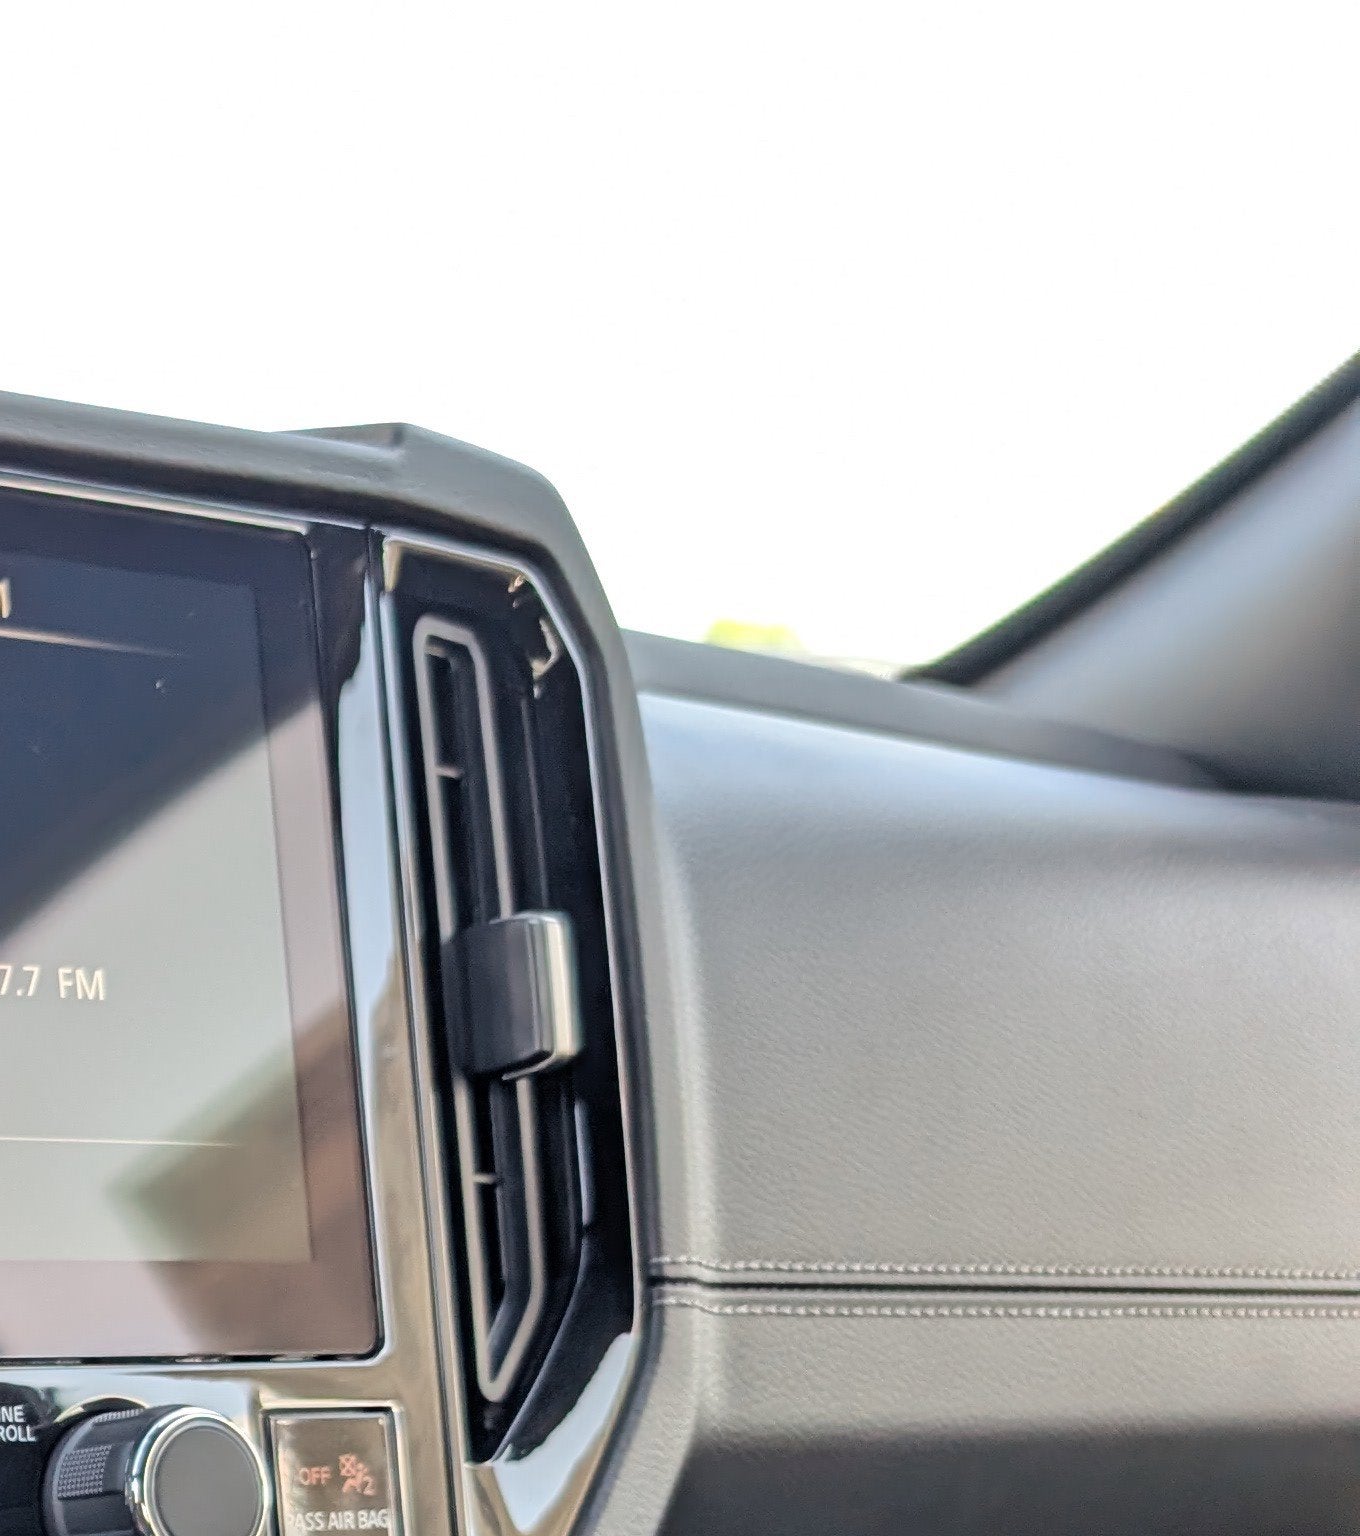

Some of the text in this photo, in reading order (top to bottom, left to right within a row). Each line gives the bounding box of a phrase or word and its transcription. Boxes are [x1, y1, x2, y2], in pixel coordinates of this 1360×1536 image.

[57, 967, 106, 1002] FM
[298, 1466, 332, 1487] OFF
[327, 1510, 356, 1530] AIR
[357, 1508, 391, 1530] BAG
